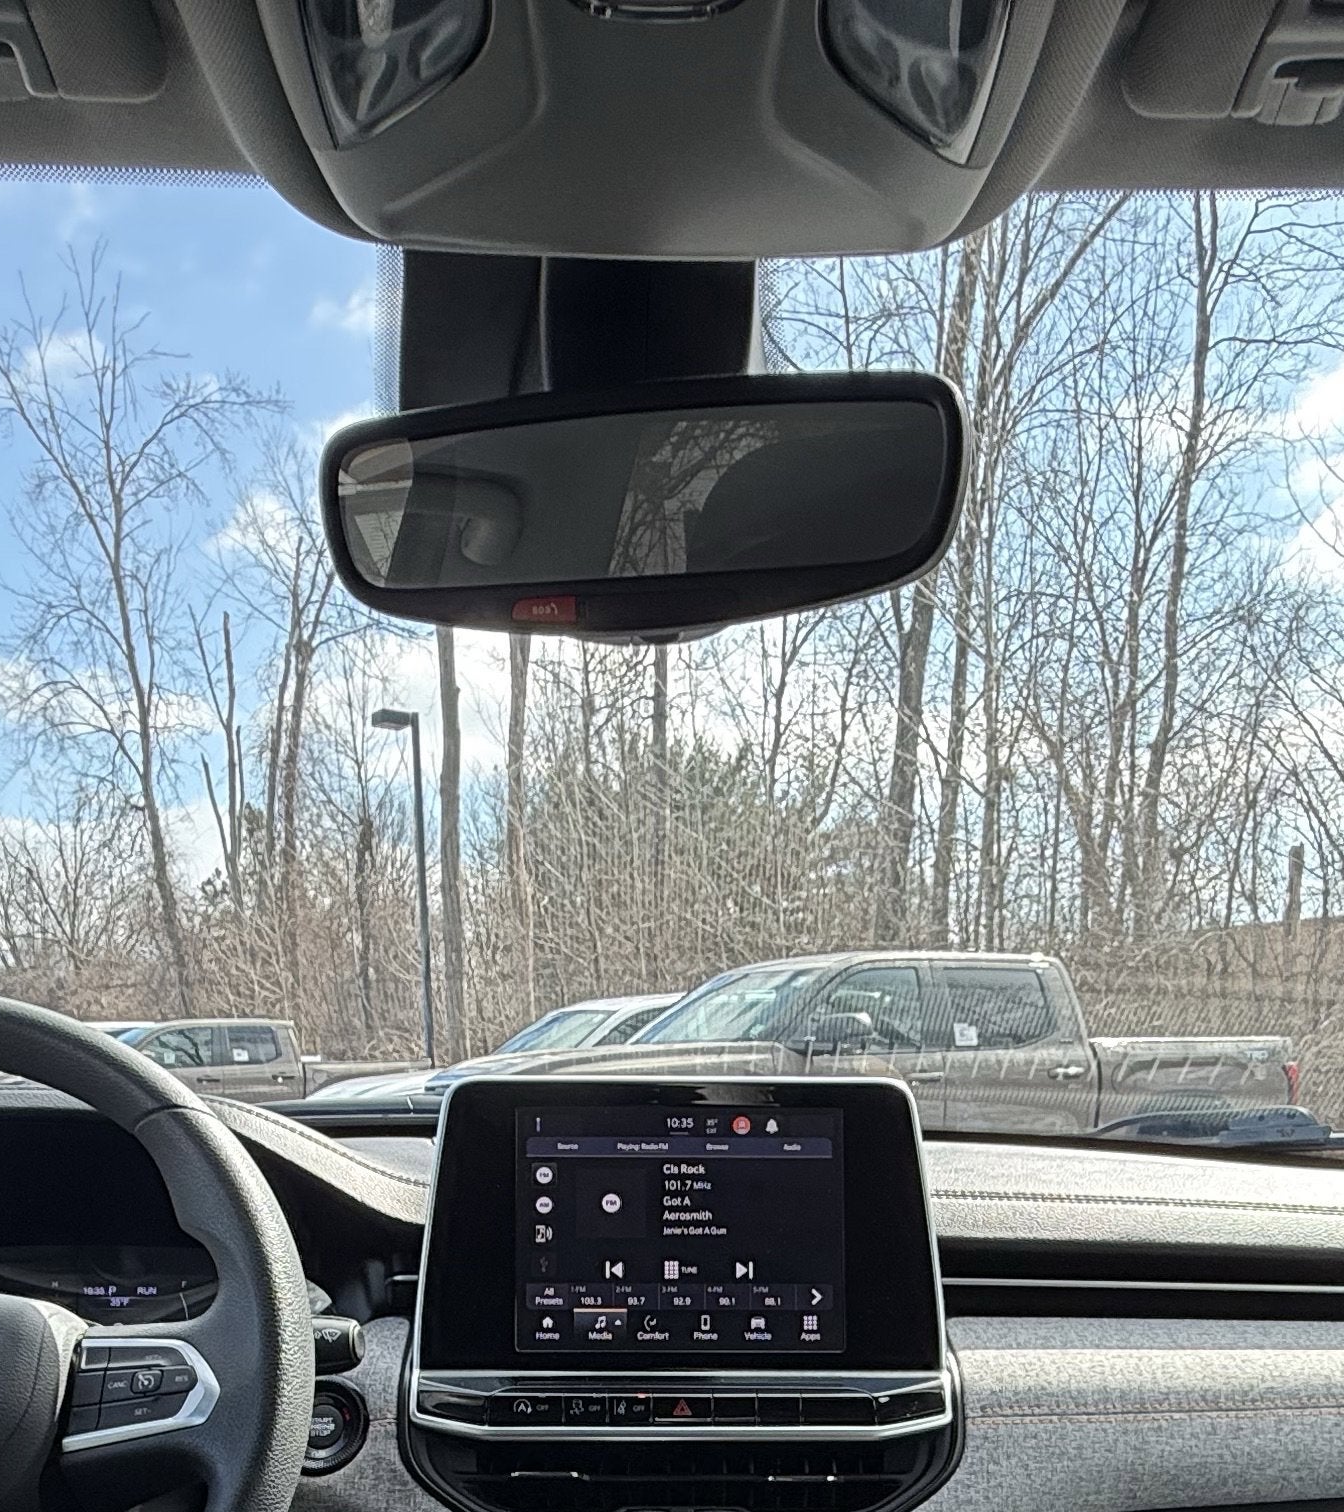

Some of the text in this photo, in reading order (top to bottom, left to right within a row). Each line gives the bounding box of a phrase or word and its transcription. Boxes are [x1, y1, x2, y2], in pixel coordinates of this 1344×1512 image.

[666, 1117, 694, 1129] 10:35
[681, 1164, 706, 1175] Rock
[664, 1180, 712, 1191] 101.7 MHz
[663, 1196, 691, 1206] Got A
[663, 1210, 713, 1221] Aerosmith
[137, 1286, 158, 1295] RUN
[535, 1331, 560, 1340] Home
[588, 1331, 613, 1340] Media
[637, 1331, 670, 1340] Comfort
[693, 1331, 718, 1341] Phone
[744, 1331, 772, 1341] Vehicle
[800, 1332, 821, 1342] Apps
